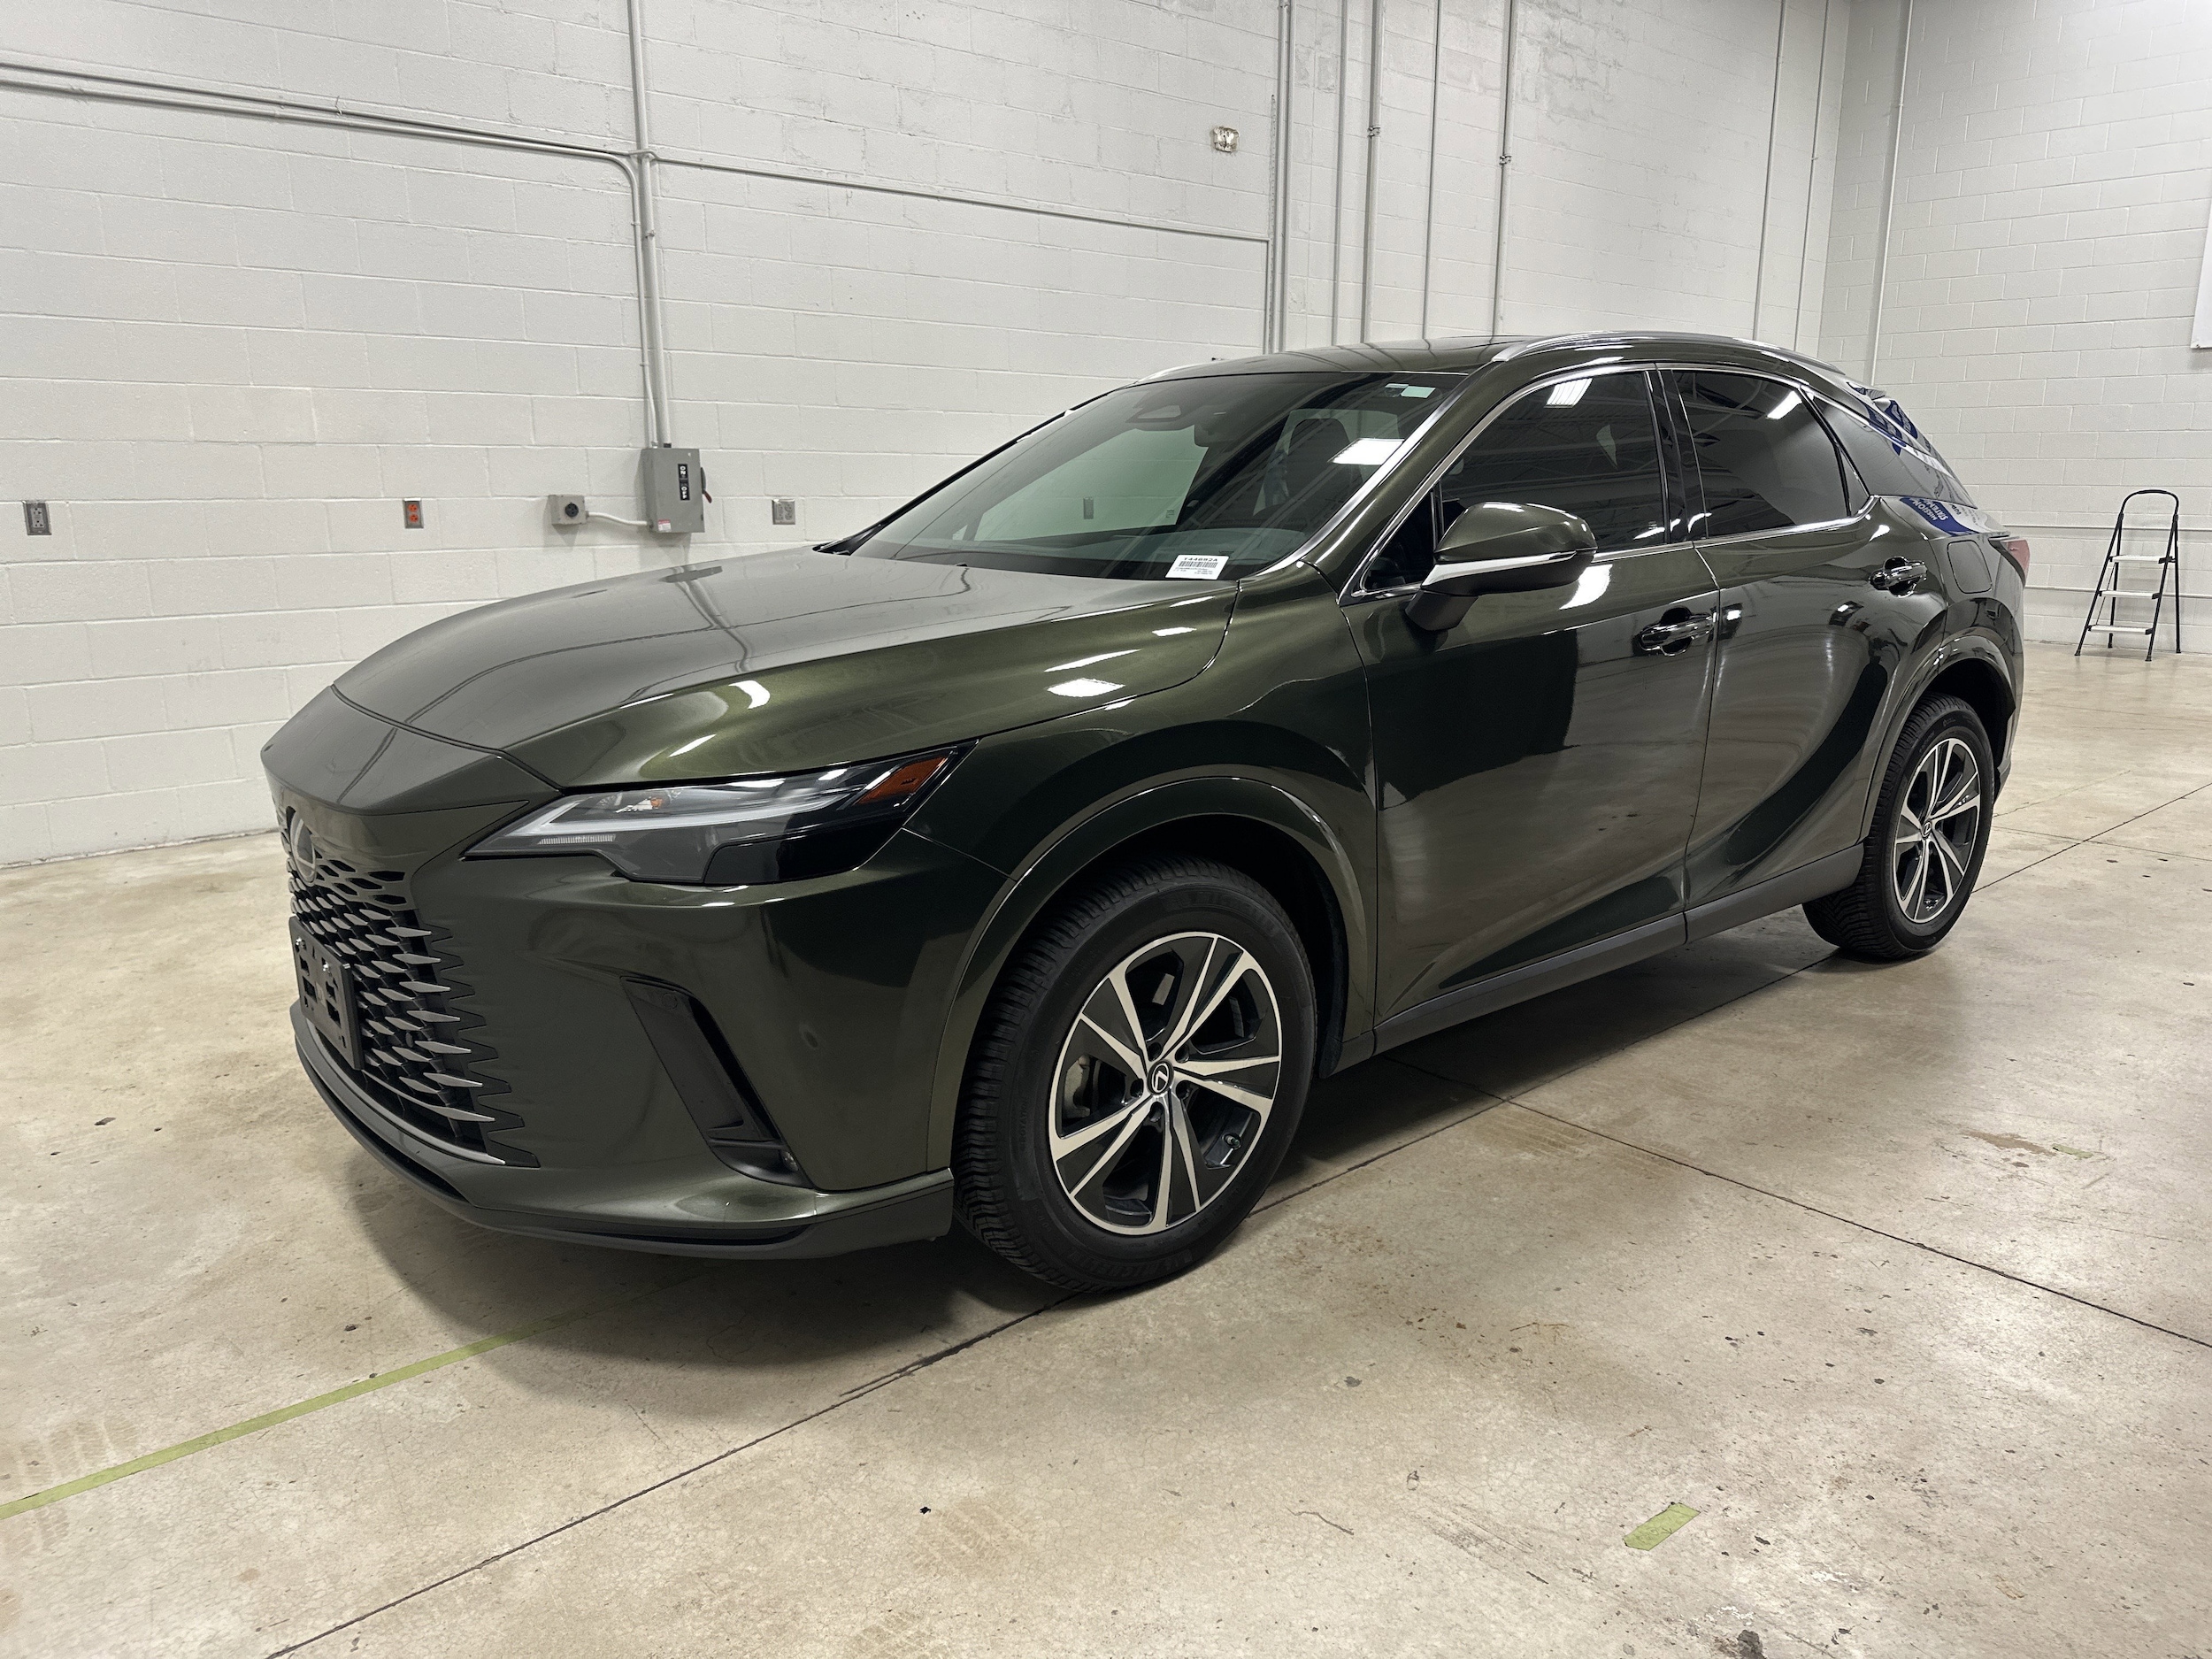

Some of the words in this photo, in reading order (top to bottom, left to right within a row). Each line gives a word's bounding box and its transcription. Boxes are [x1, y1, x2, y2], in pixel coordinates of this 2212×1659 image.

[680, 465, 687, 475] ON
[1912, 500, 1938, 520] MISSION
[1923, 499, 1948, 521] STATEM
[1067, 1248, 1159, 1278] MICHELIN
